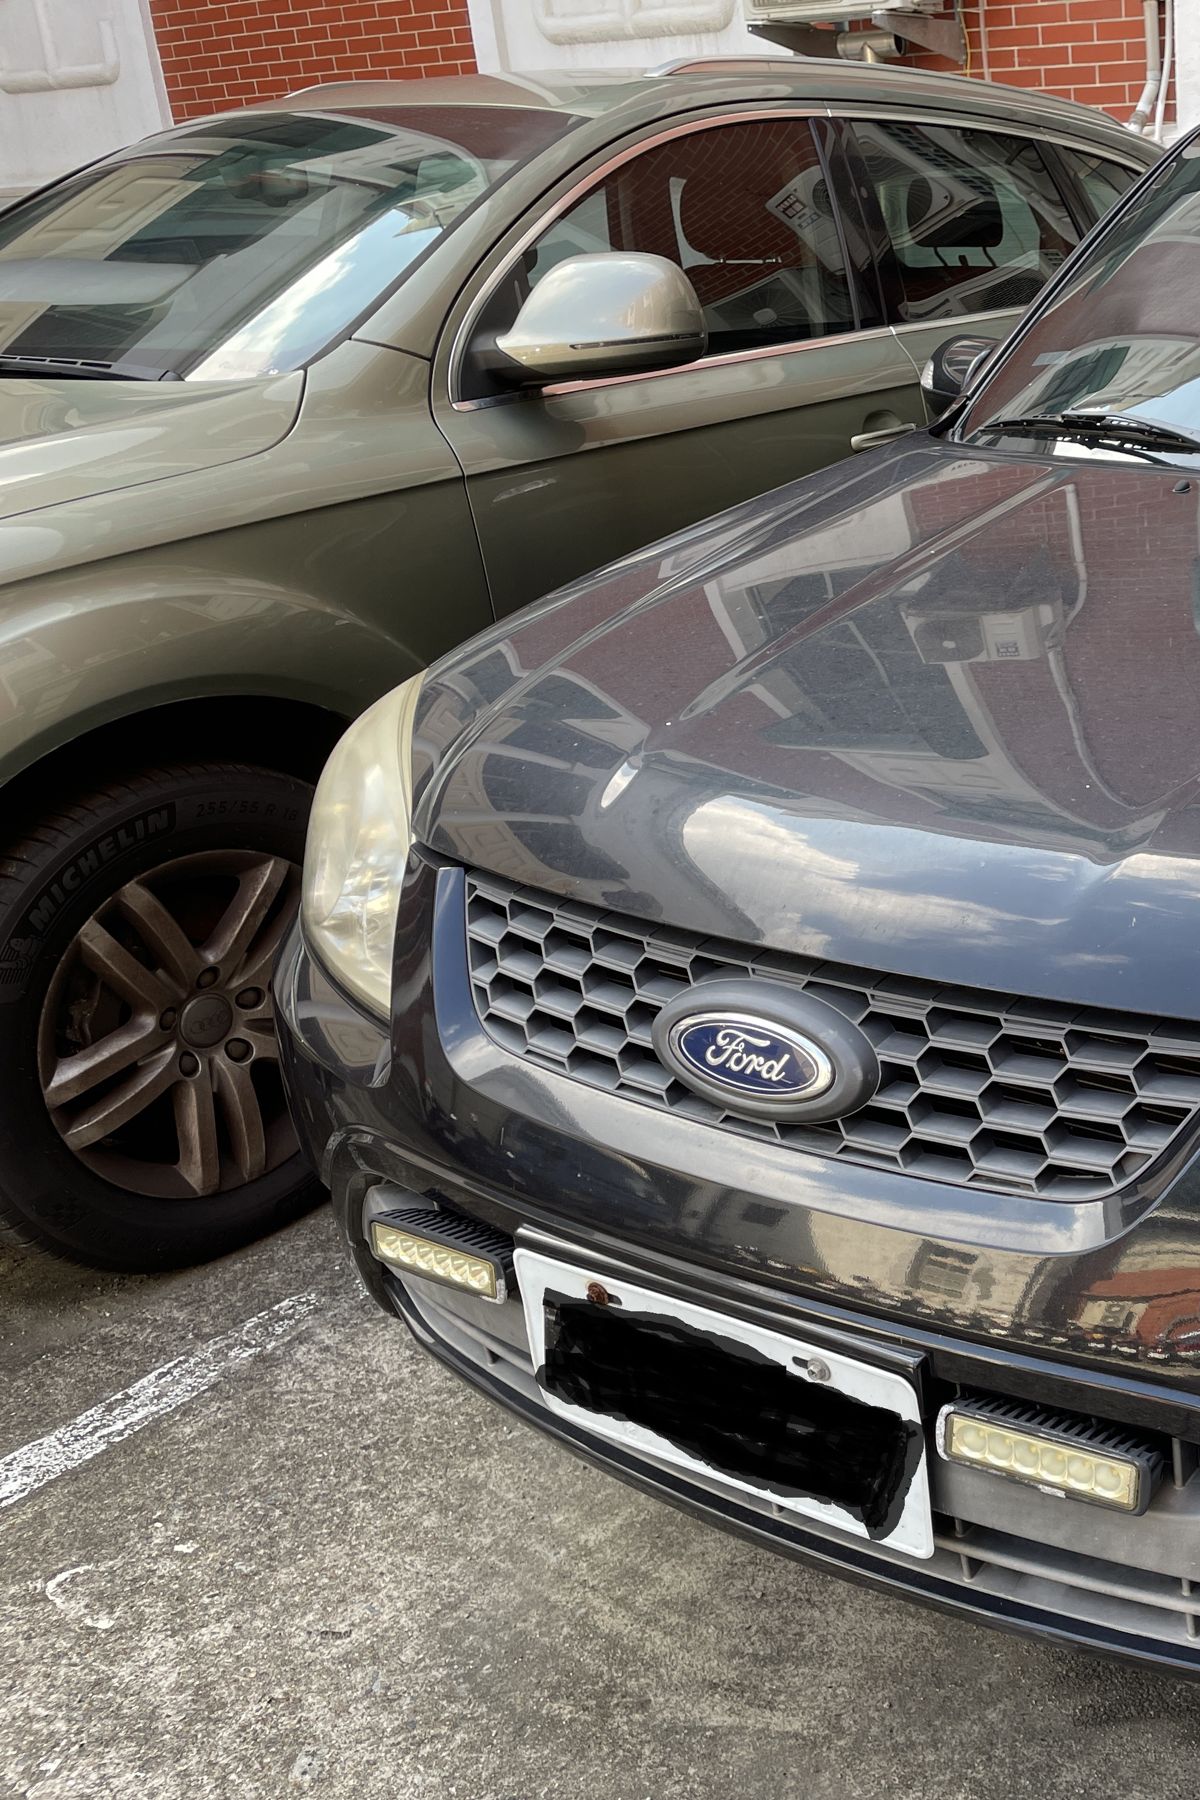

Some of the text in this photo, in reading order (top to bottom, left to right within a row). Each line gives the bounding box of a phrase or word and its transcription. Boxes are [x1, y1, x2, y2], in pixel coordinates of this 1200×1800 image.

[196, 799, 259, 818] 255/55
[28, 808, 169, 932] MICHELIN
[705, 1029, 794, 1084] Ford
